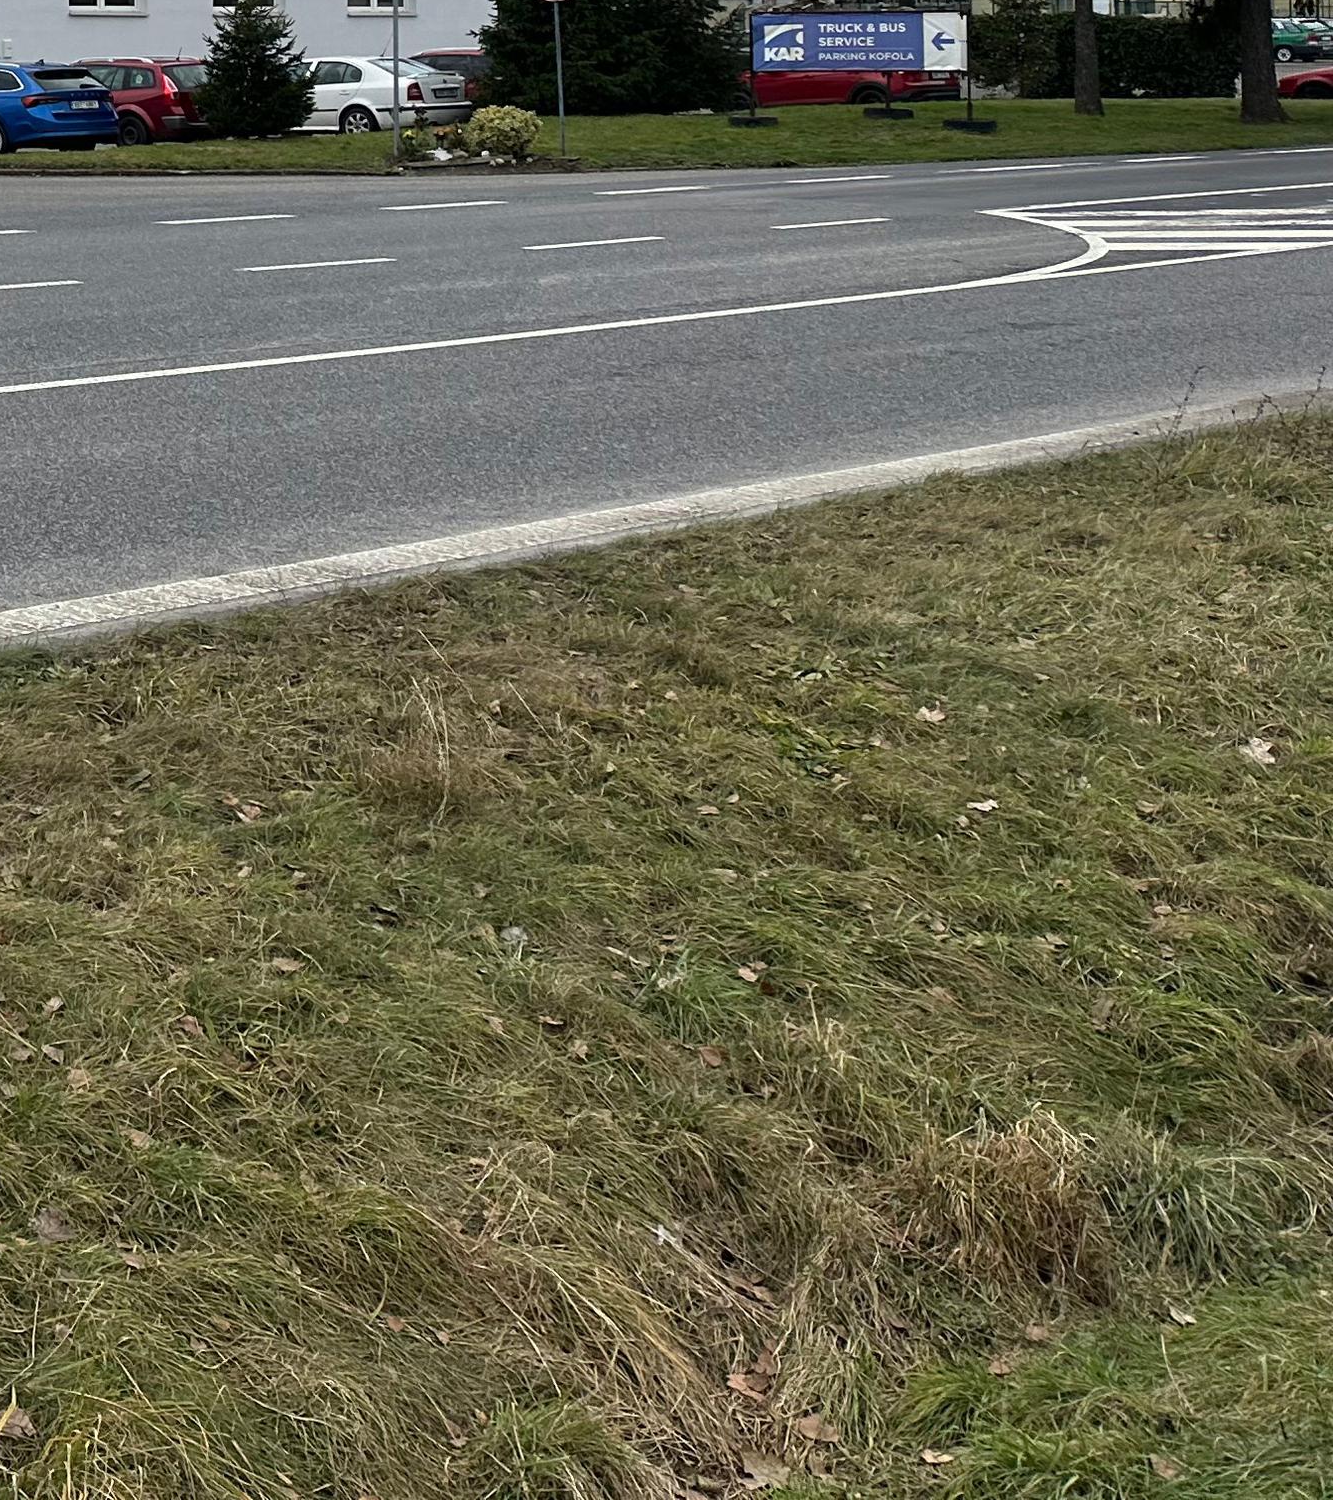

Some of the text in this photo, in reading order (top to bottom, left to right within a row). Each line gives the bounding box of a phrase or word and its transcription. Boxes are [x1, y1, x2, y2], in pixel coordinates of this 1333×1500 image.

[818, 22, 906, 33] TRUCK & BUS
[818, 37, 874, 46] SERVICE
[764, 47, 805, 62] KAR
[818, 52, 915, 61] PARKING KOFOLA
